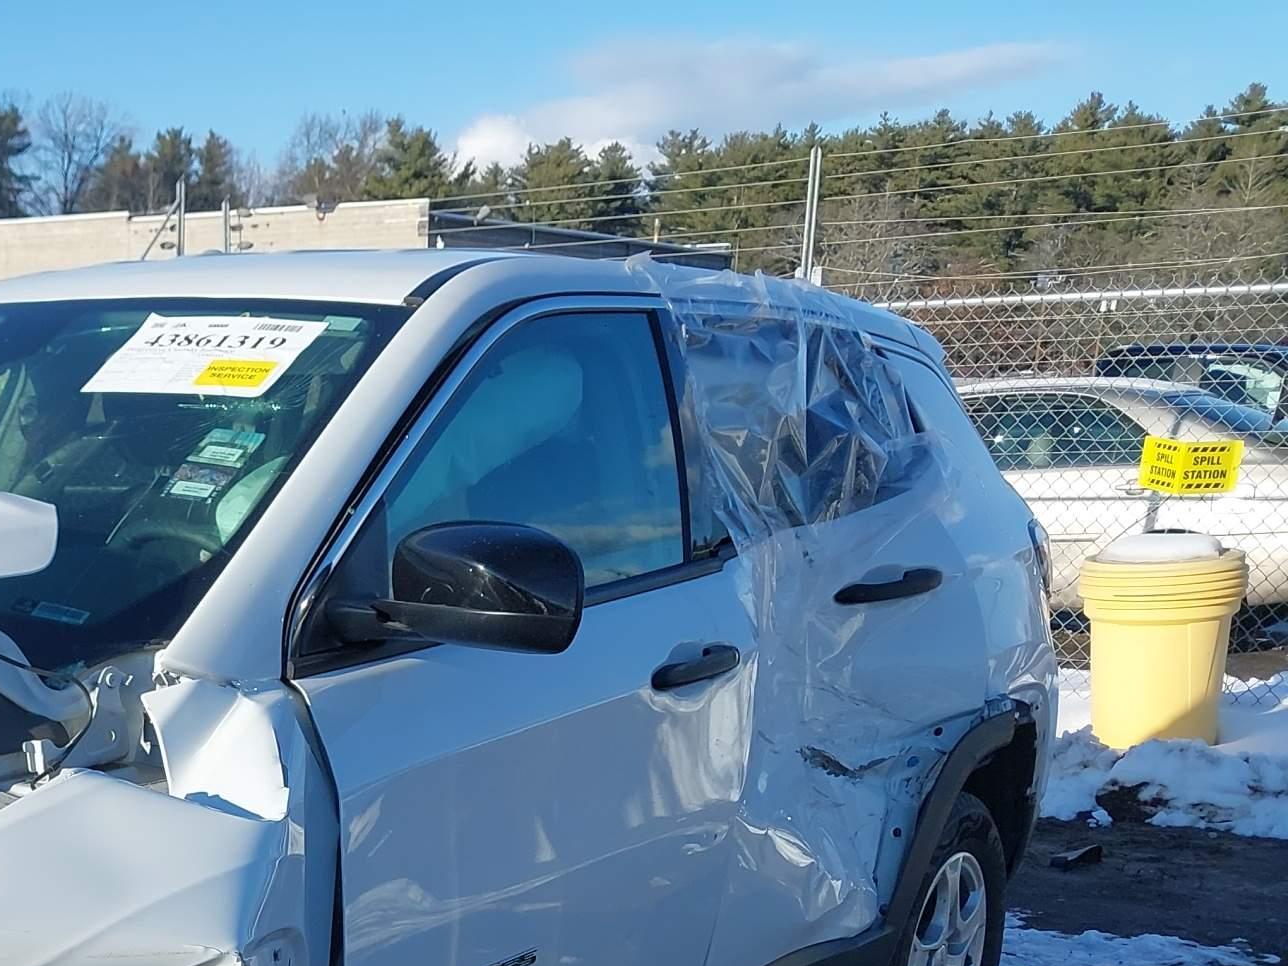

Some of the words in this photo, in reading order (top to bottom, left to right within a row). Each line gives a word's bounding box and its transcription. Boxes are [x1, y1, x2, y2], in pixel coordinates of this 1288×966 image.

[144, 332, 287, 350] 43861319
[207, 365, 271, 374] INSPECTION
[209, 372, 257, 380] SERVICE
[1156, 452, 1174, 465] SPILL
[1192, 455, 1223, 466] SPILL
[1149, 465, 1177, 479] STATION
[1182, 469, 1228, 480] STATION
